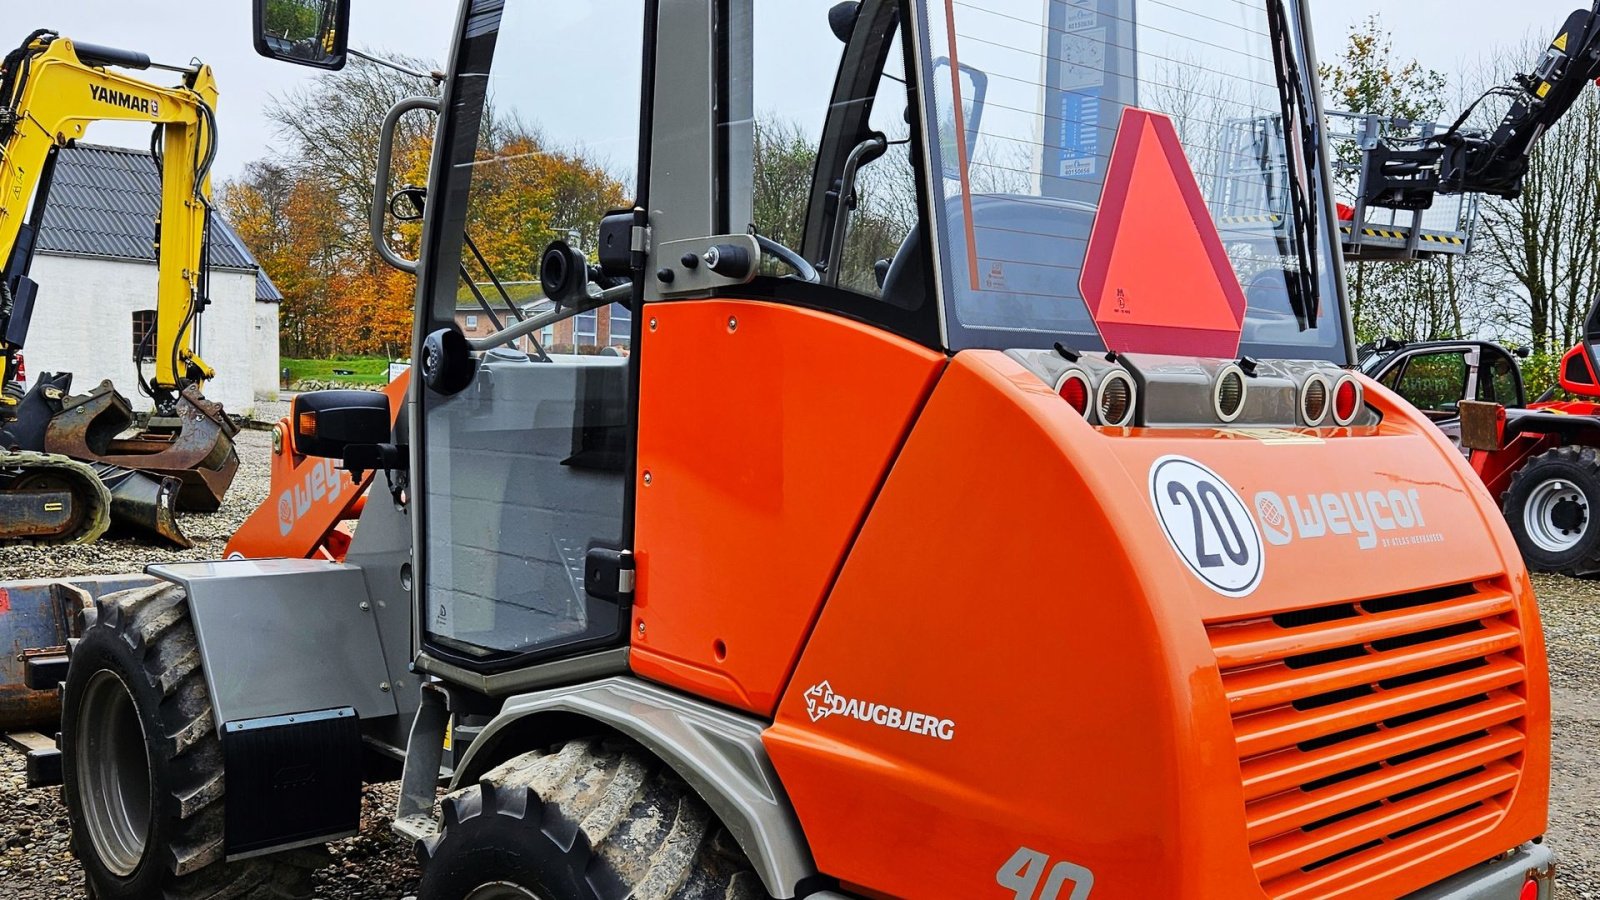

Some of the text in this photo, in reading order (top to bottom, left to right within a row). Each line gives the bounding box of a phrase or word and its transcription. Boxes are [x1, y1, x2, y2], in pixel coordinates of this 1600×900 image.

[89, 83, 149, 113] YANMAR
[1167, 480, 1249, 568] 20
[1289, 488, 1425, 550] weycor
[832, 694, 955, 740] DAUGBJERG
[996, 846, 1094, 900] 40
